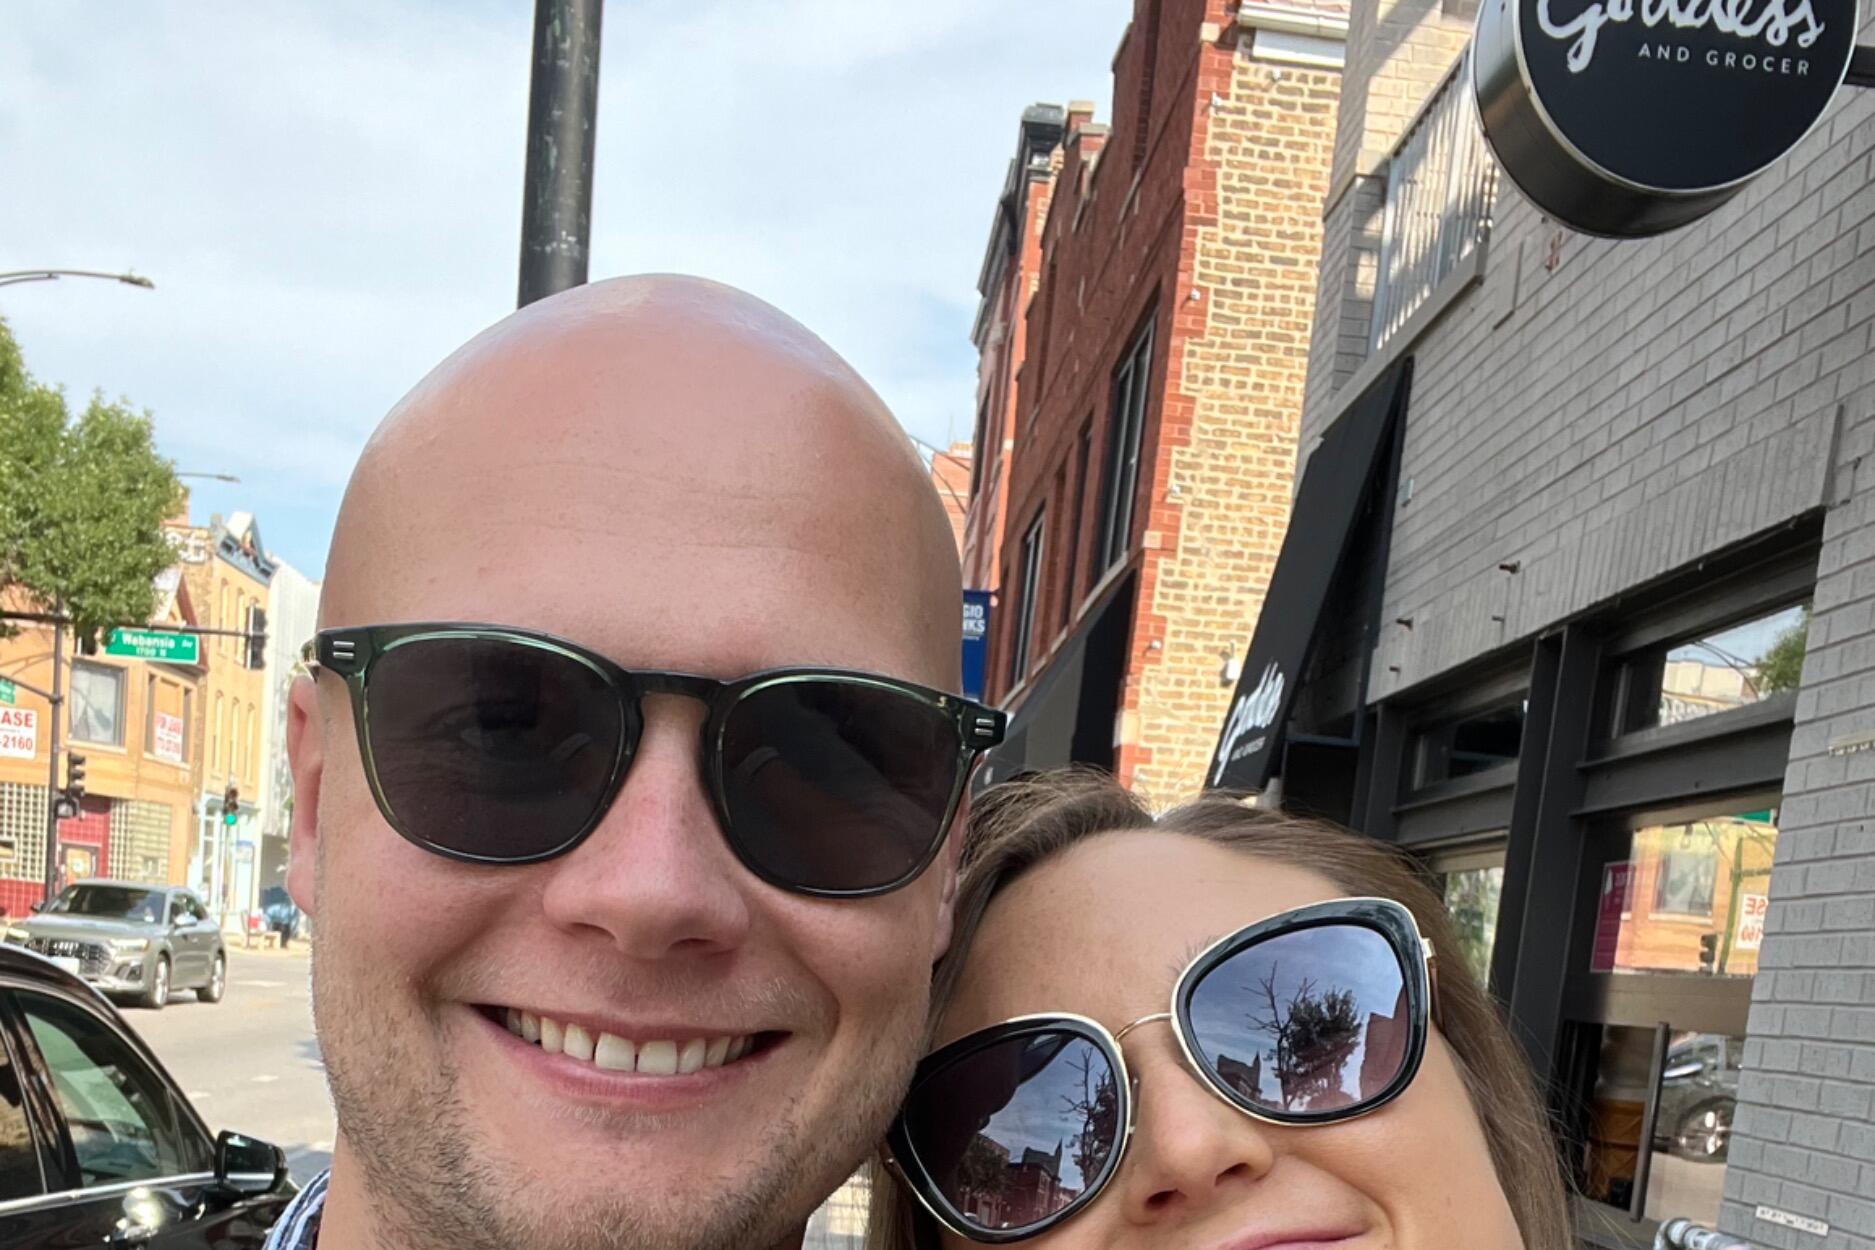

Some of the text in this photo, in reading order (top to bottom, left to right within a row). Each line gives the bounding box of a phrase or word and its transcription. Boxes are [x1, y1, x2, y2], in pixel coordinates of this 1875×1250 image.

[1638, 43, 1811, 75] AND GROCER
[122, 633, 175, 649] Wabansia
[1, 710, 33, 728] ASE
